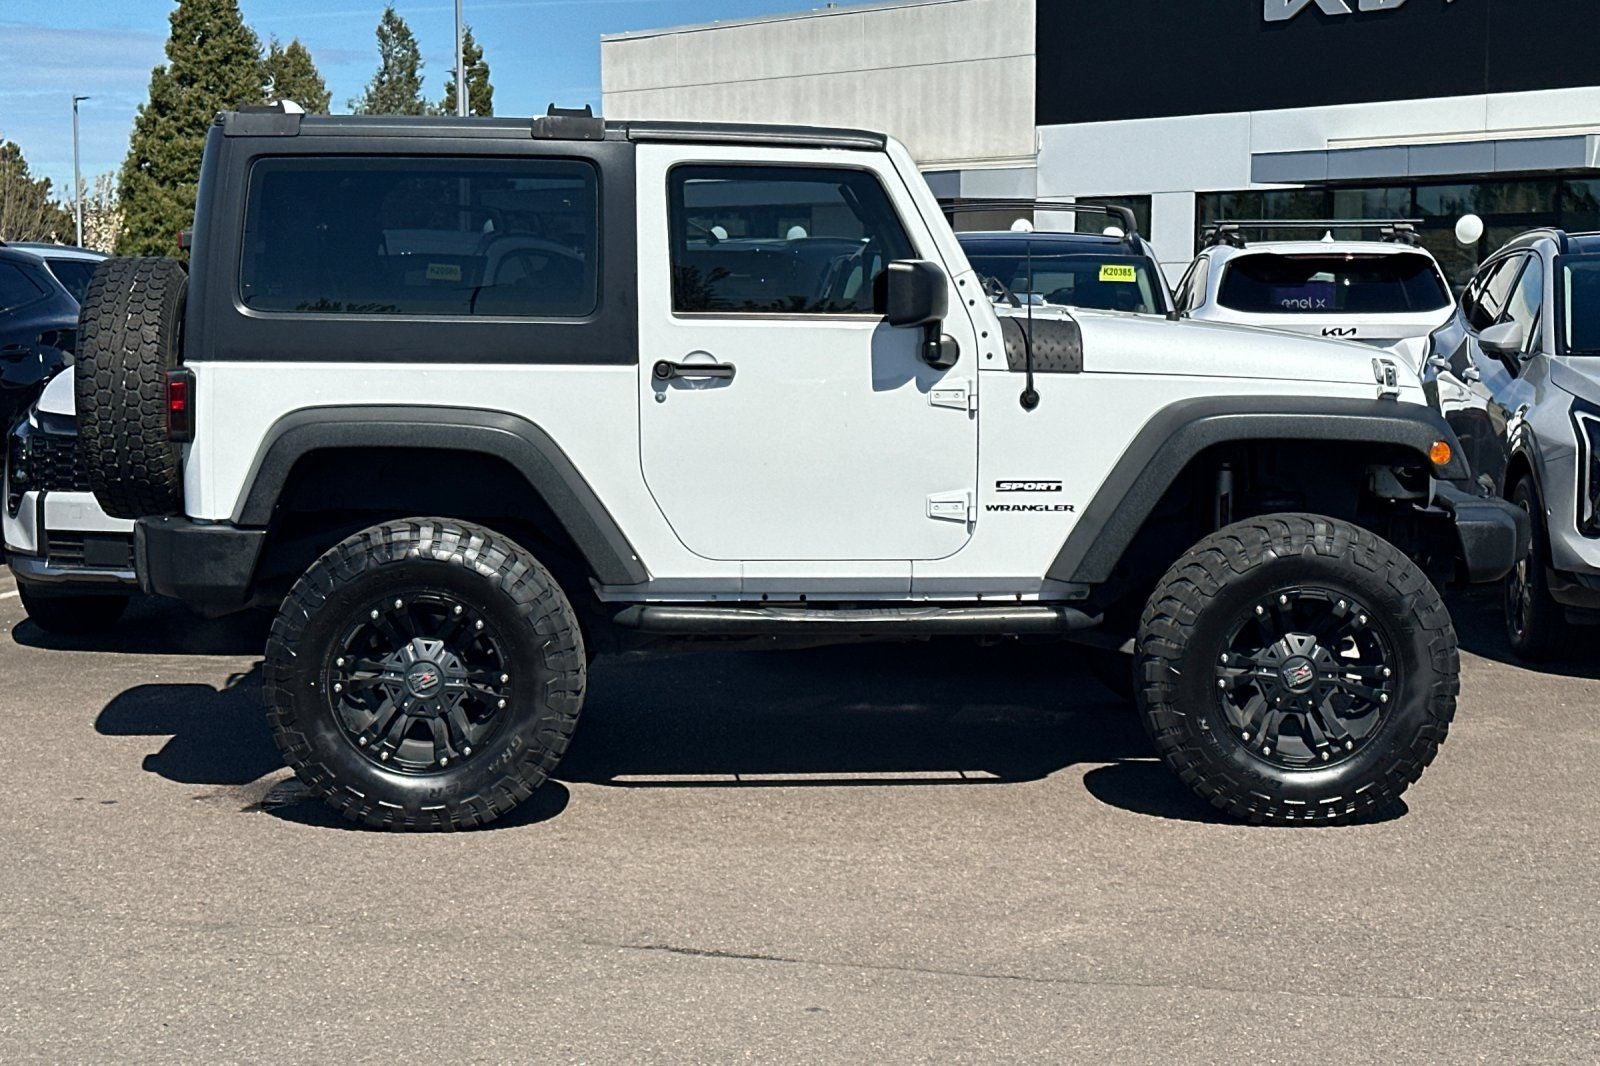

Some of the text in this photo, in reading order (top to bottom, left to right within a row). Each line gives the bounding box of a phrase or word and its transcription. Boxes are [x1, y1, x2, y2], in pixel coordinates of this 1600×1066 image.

[1103, 267, 1132, 277] K20385
[1281, 296, 1312, 309] enel
[999, 481, 1059, 491] SPORT
[985, 504, 1075, 512] WRANGLER
